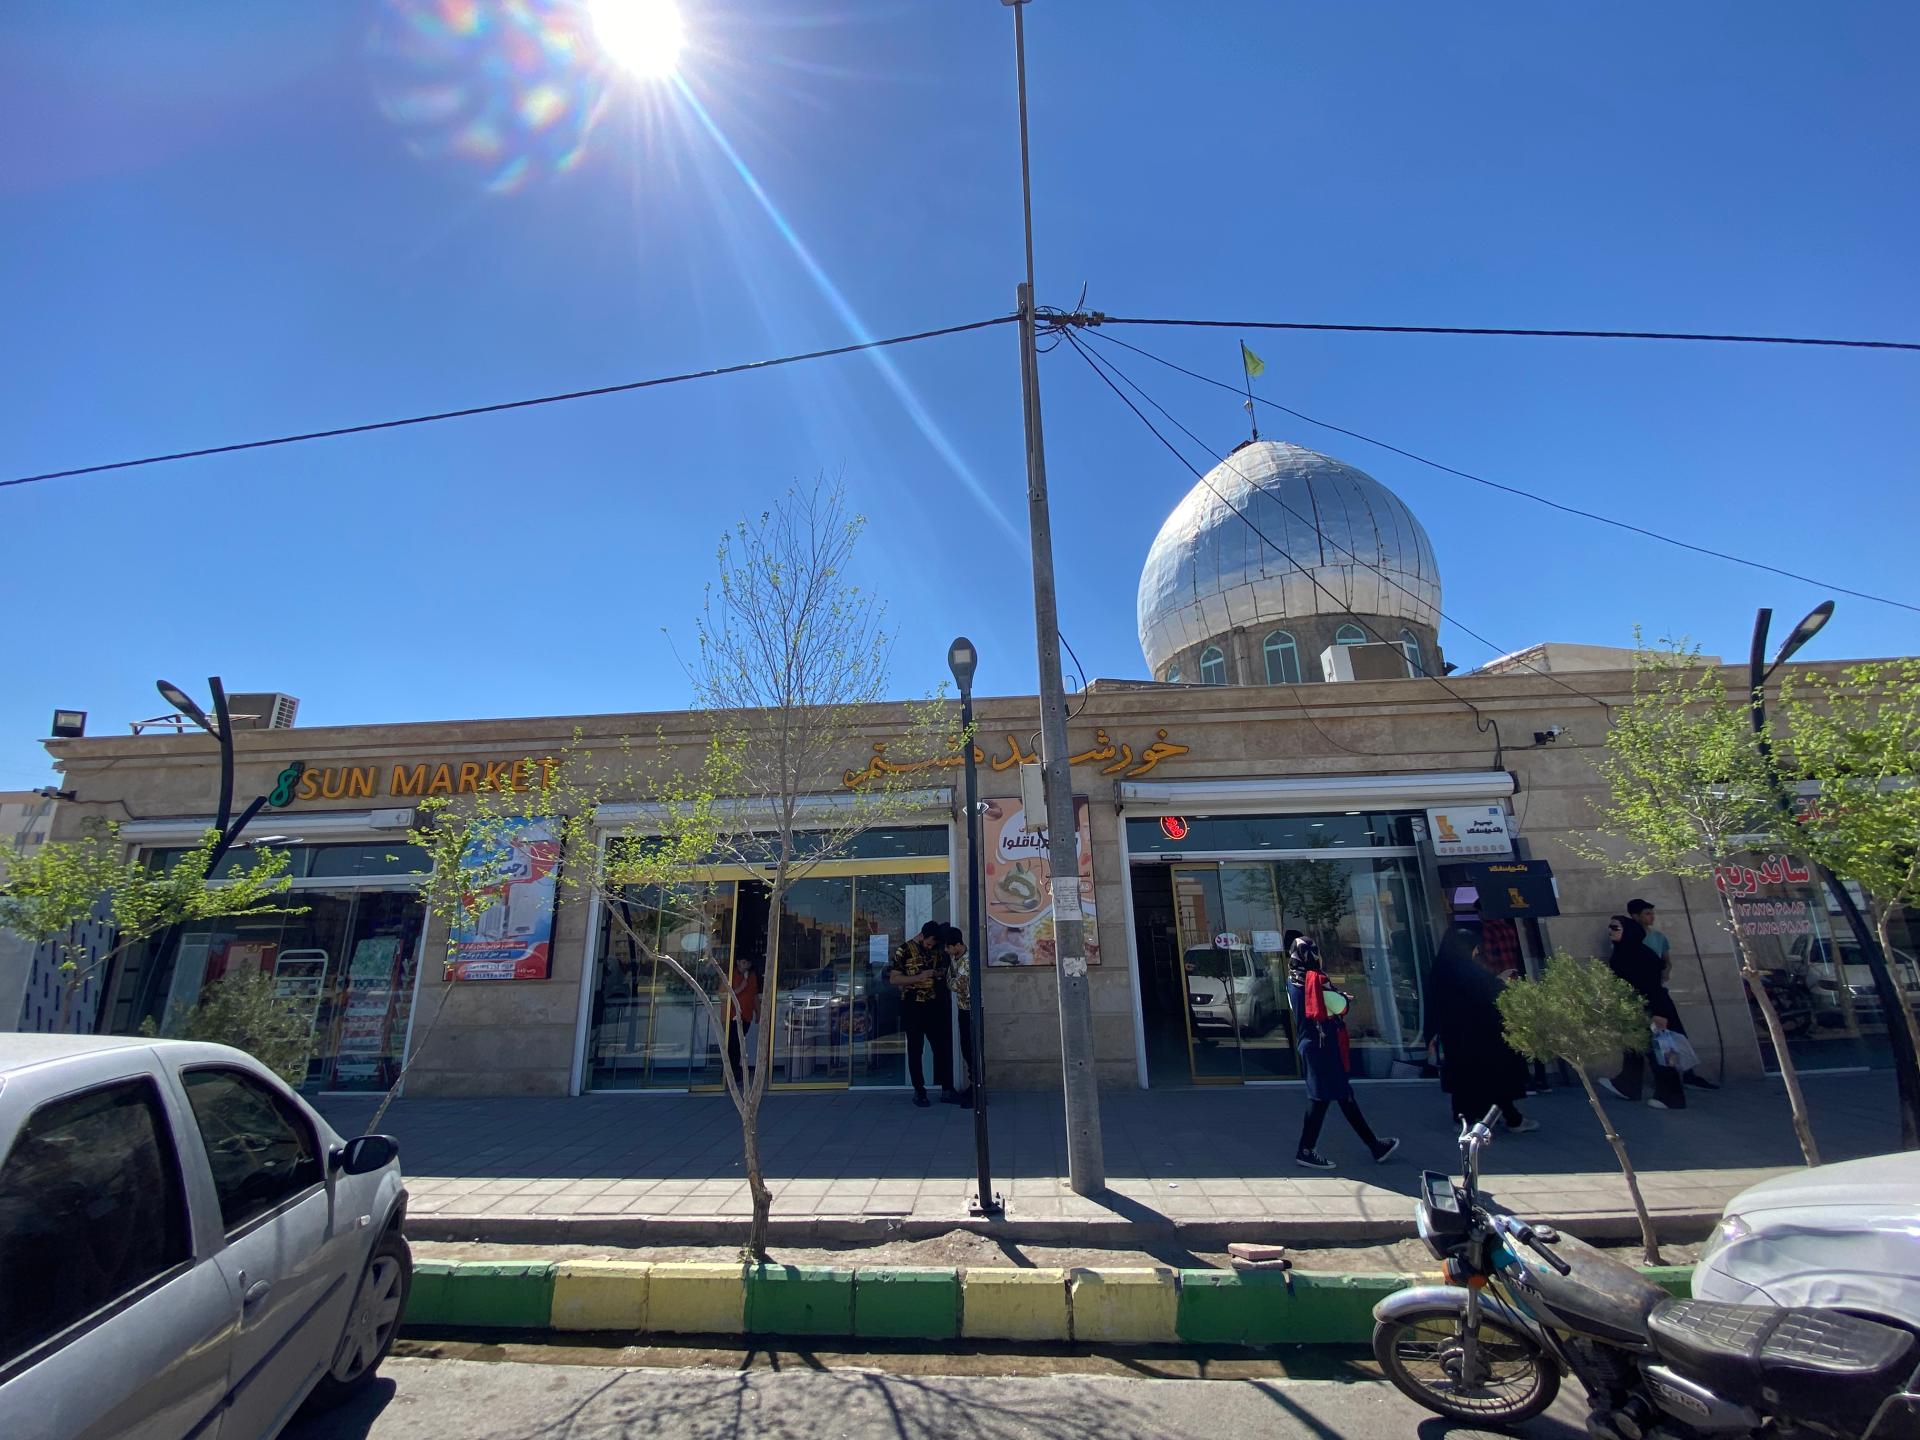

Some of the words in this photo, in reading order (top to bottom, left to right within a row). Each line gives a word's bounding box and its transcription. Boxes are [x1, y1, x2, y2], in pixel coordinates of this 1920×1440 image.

[297, 765, 377, 801] SUN
[390, 757, 560, 797] MARKET
[1002, 836, 1041, 850] باقلوا
[1714, 855, 1809, 898] ساندویچ
